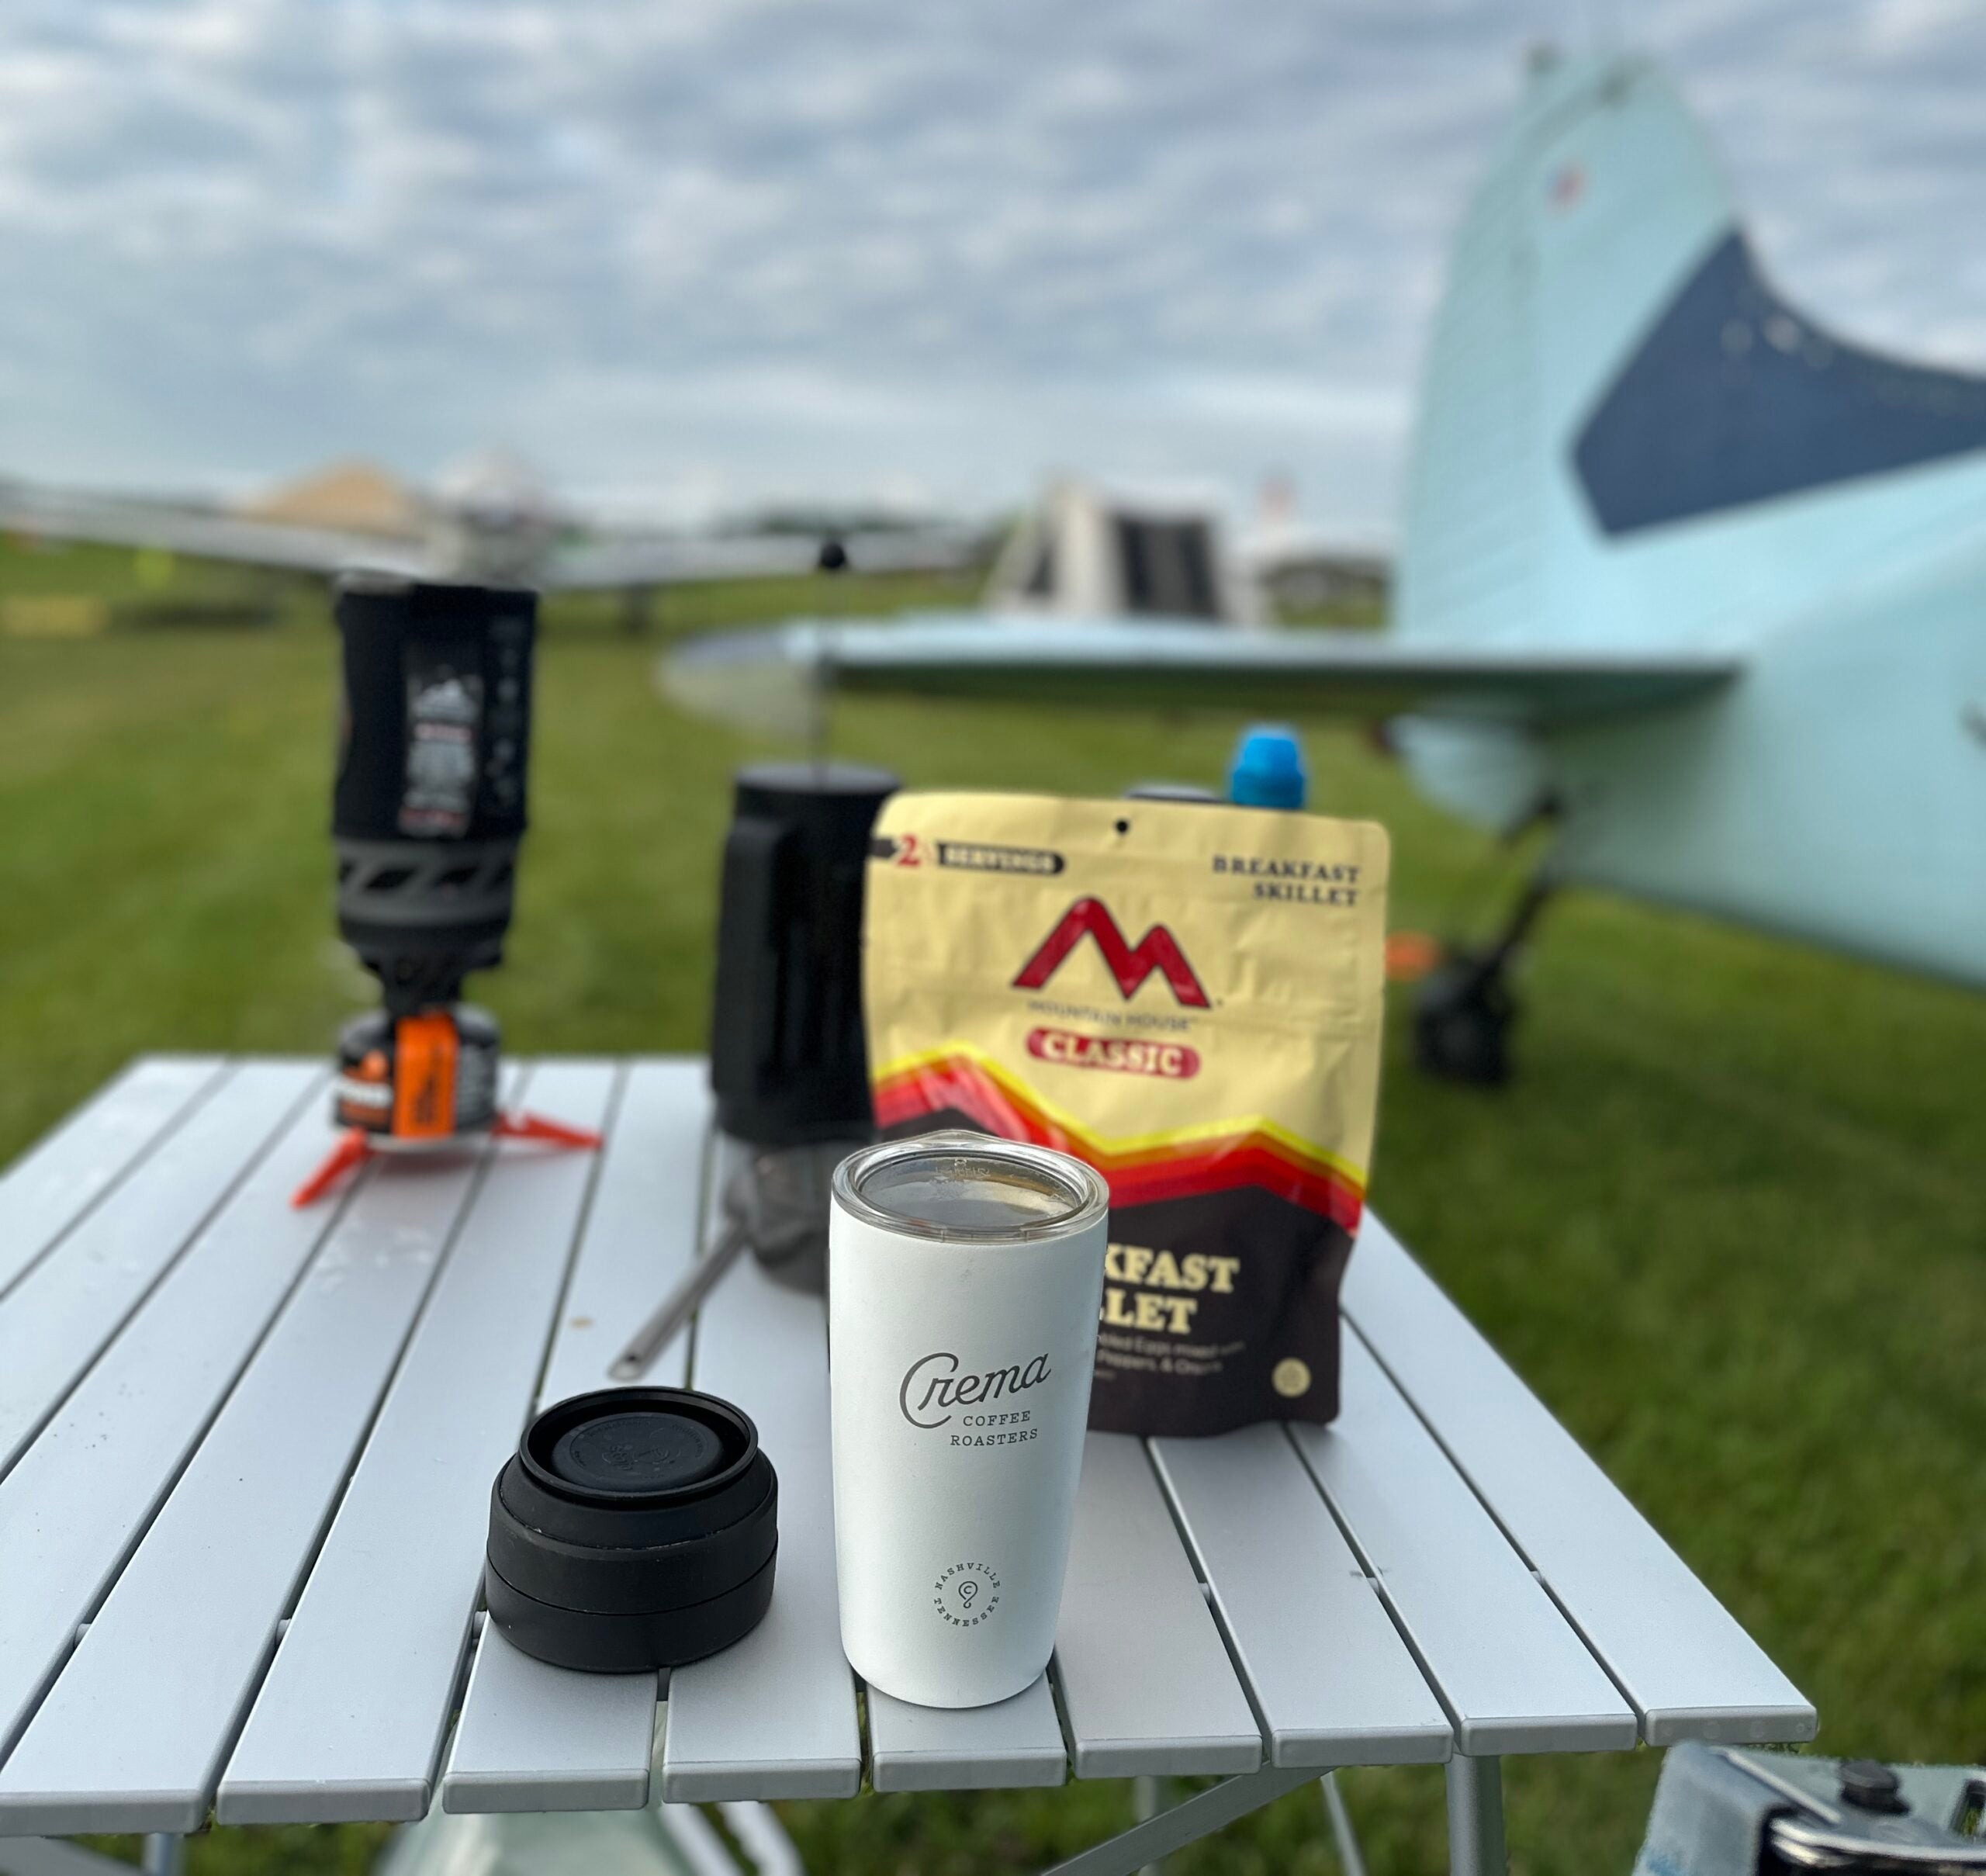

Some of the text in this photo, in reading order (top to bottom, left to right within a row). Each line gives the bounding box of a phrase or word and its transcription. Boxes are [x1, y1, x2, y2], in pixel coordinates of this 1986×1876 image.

[944, 848, 1055, 873] SERVINGS
[1213, 856, 1361, 883] BREAKFAST
[1254, 883, 1358, 906] SKILLET
[1041, 1033, 1184, 1076] CLASSIC
[1099, 1287, 1198, 1334] LET
[899, 1352, 1052, 1429] Crema
[963, 1410, 1031, 1427] COFFEE
[950, 1428, 1038, 1447] ROASTERS
[934, 1563, 1001, 1590] NASHVILLE
[933, 1596, 1000, 1627] TENNESSEE
